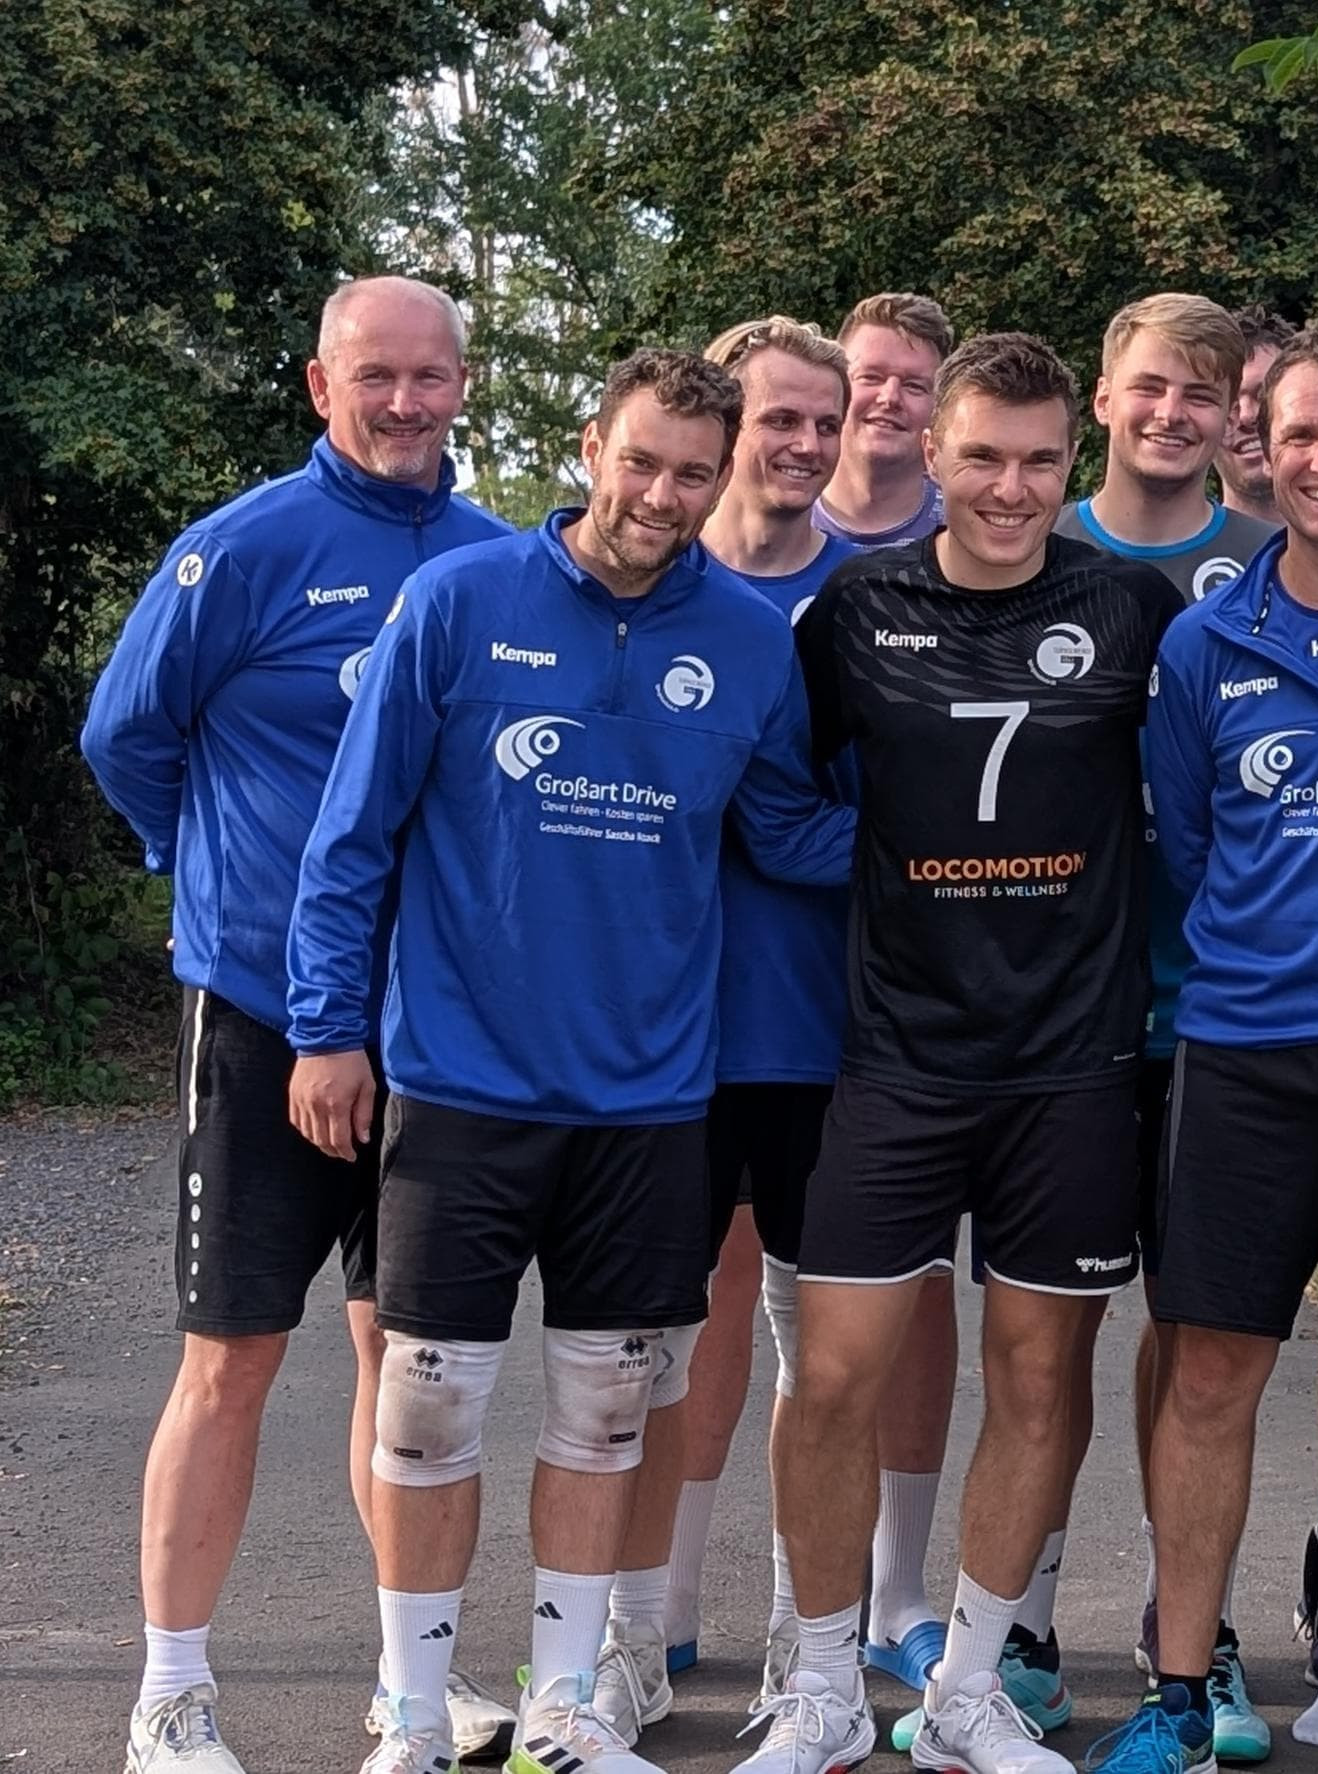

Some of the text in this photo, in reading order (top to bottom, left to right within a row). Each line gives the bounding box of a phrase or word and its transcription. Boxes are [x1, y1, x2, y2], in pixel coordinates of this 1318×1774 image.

[306, 585, 370, 607] Kempa
[875, 629, 938, 652] Kempa
[491, 642, 557, 668] Kempa
[1220, 676, 1279, 700] Kempa
[950, 701, 1030, 822] 7
[535, 772, 677, 811] Großart Drive
[909, 852, 1087, 881] LOCOMOTION
[934, 886, 987, 898] FITNESS
[1005, 883, 1068, 897] WELLNESS
